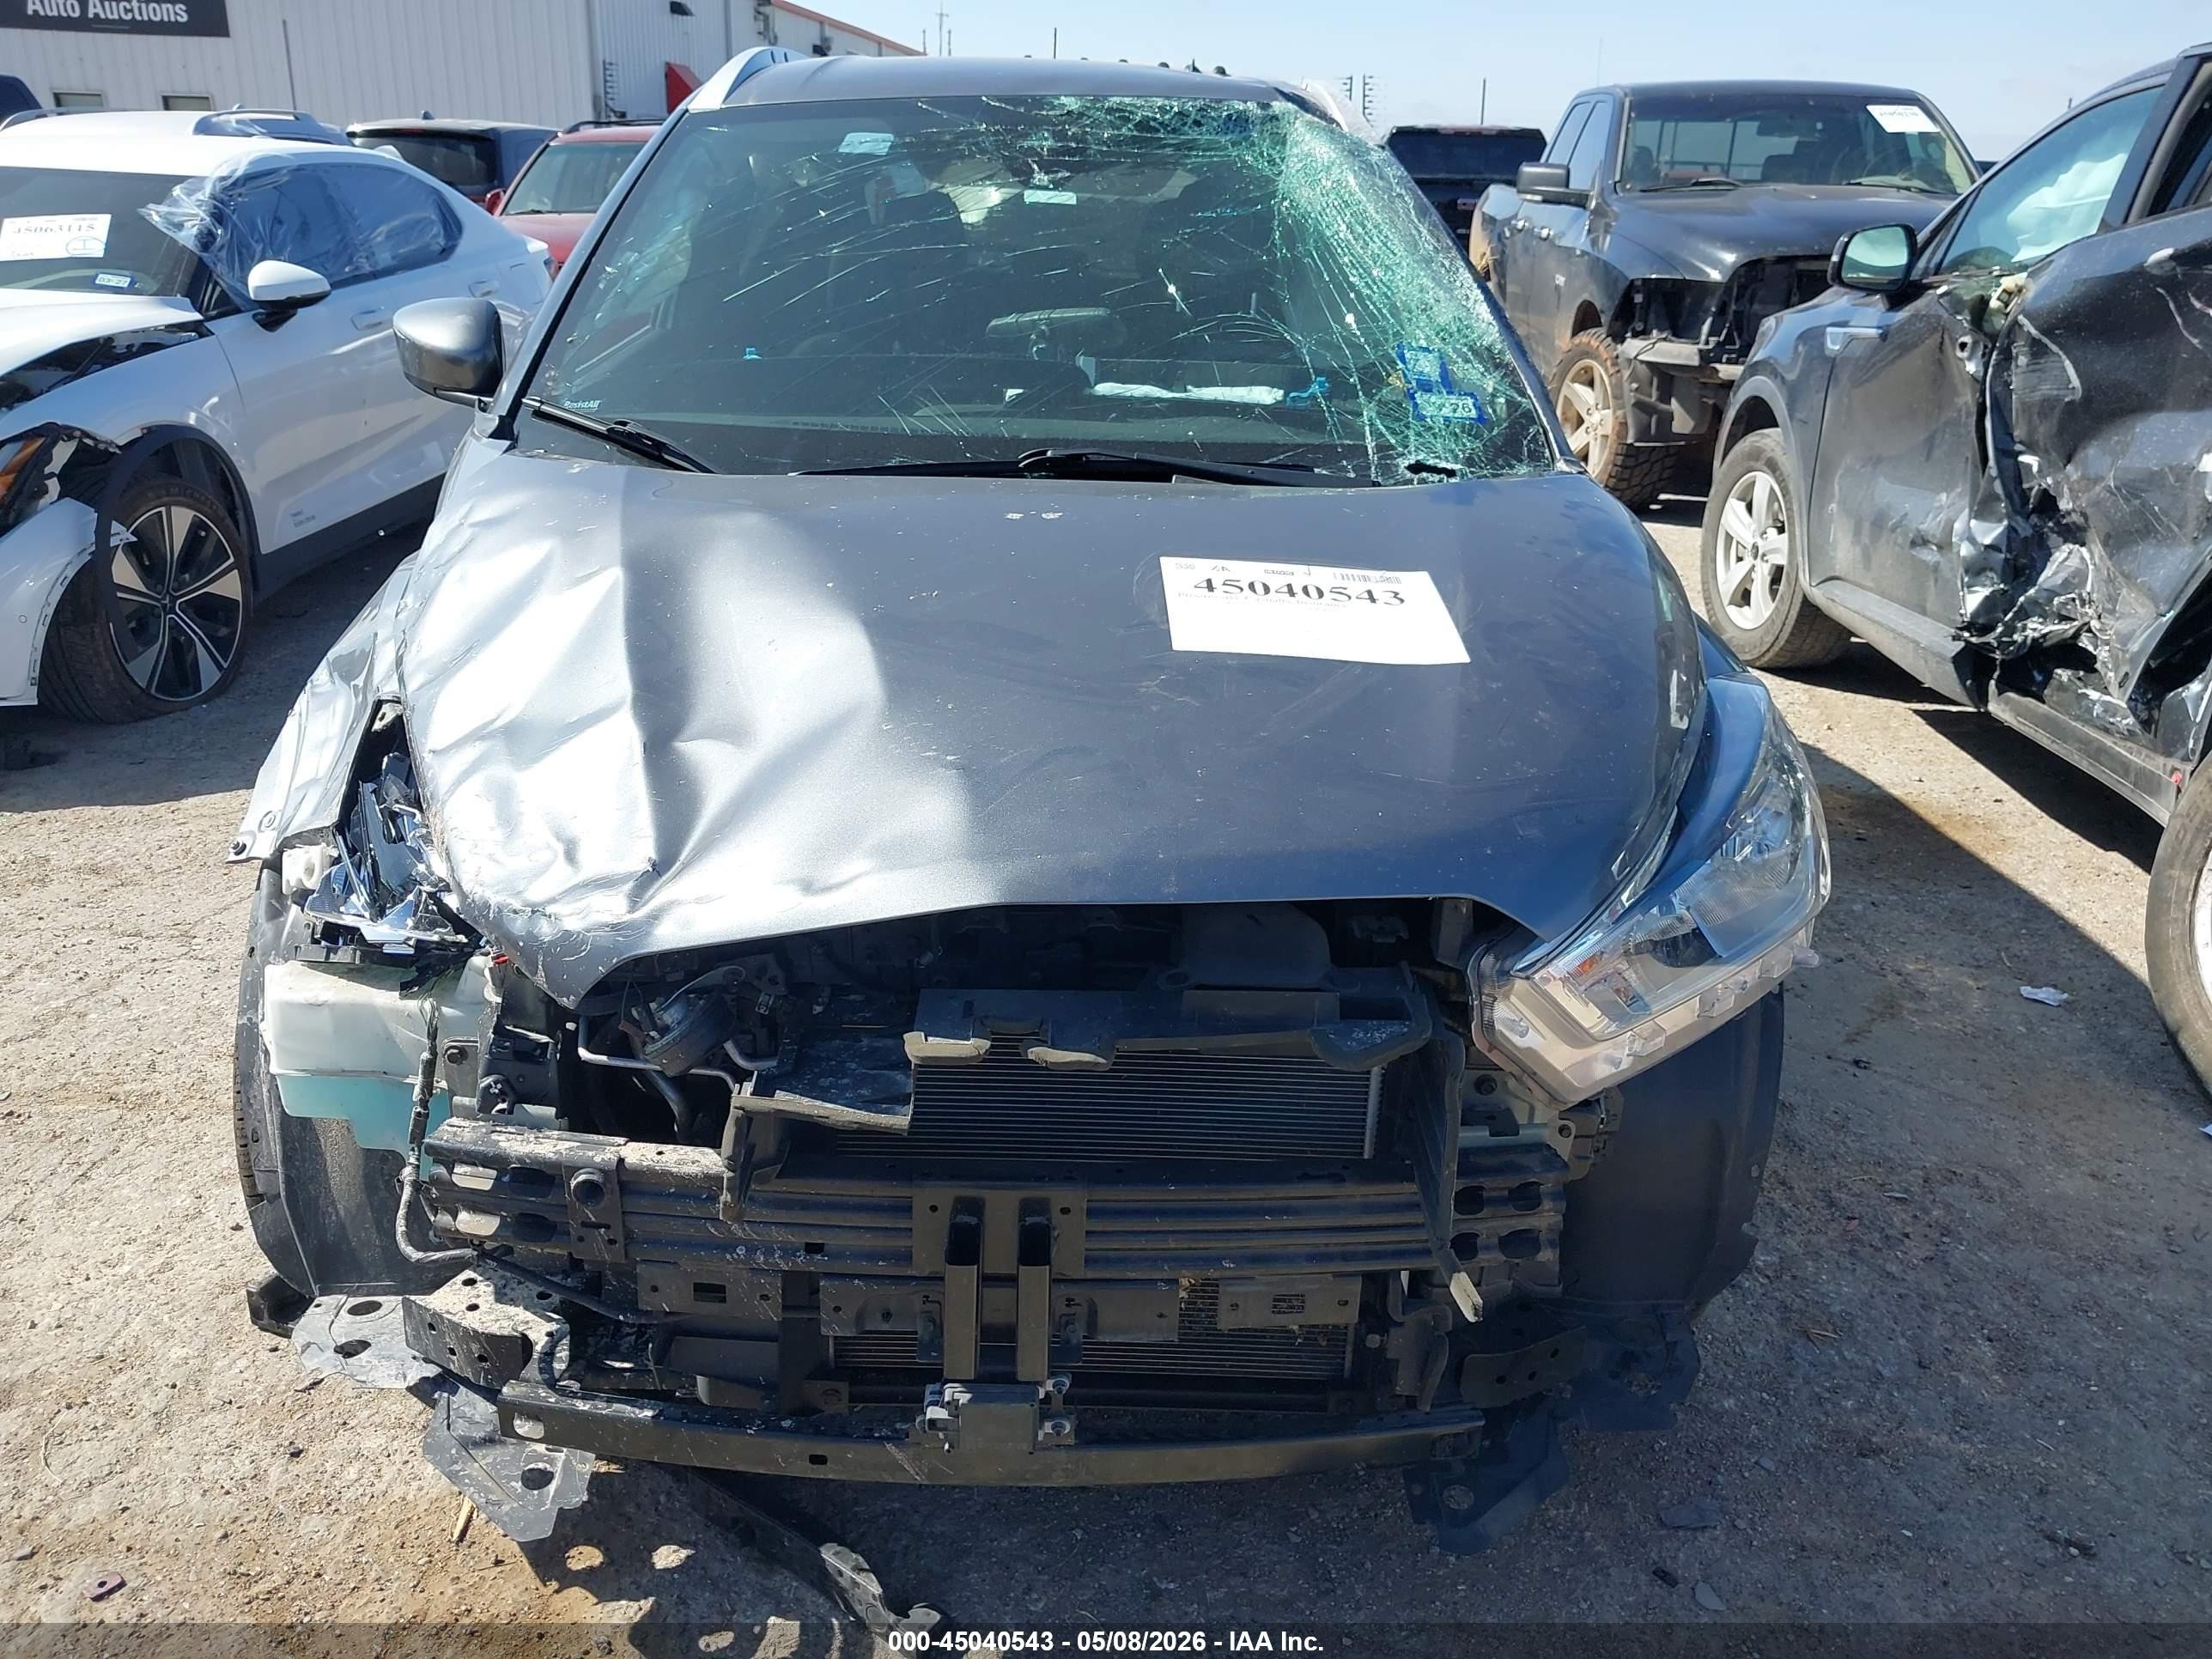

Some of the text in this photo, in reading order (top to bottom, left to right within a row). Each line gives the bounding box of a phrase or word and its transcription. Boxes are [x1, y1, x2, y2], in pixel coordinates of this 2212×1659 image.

[27, 0, 189, 22] Auto Auctions
[1194, 578, 1406, 606] 45040543
